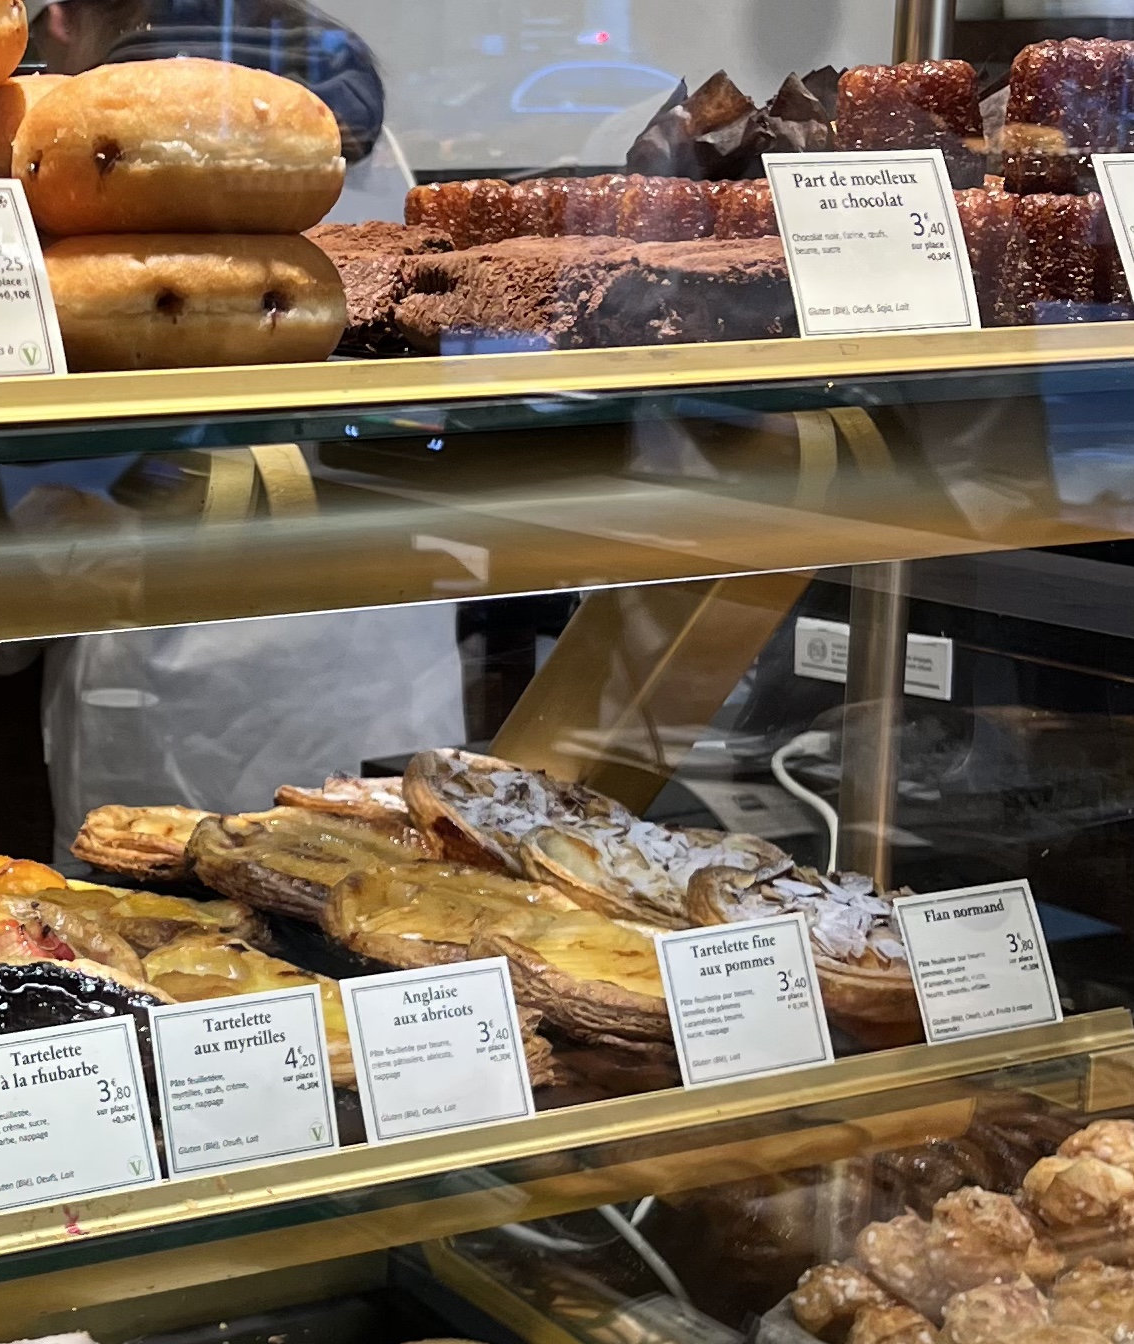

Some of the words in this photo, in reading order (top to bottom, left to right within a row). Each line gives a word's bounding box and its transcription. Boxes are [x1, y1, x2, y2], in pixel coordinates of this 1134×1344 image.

[792, 172, 826, 189] Part
[830, 171, 848, 187] de
[850, 170, 918, 186] moelleux
[820, 197, 838, 210] au
[841, 193, 904, 209] chocolat
[925, 907, 951, 924] Flan
[953, 899, 1004, 917] normand
[690, 937, 749, 959] Tartelette
[752, 934, 776, 953] fine
[700, 962, 722, 977] aux
[725, 954, 775, 977] pommes
[403, 985, 459, 1005] Anglaise
[203, 1011, 272, 1033] Tartelette
[393, 1013, 418, 1027] aux
[421, 1004, 474, 1023] abricots
[194, 1043, 220, 1055] aux
[224, 1029, 286, 1053] myrtilles
[10, 1043, 82, 1067] Tartelette
[0, 1075, 10, 1091] à
[14, 1073, 28, 1088] la
[32, 1061, 99, 1086] rhubarbe
